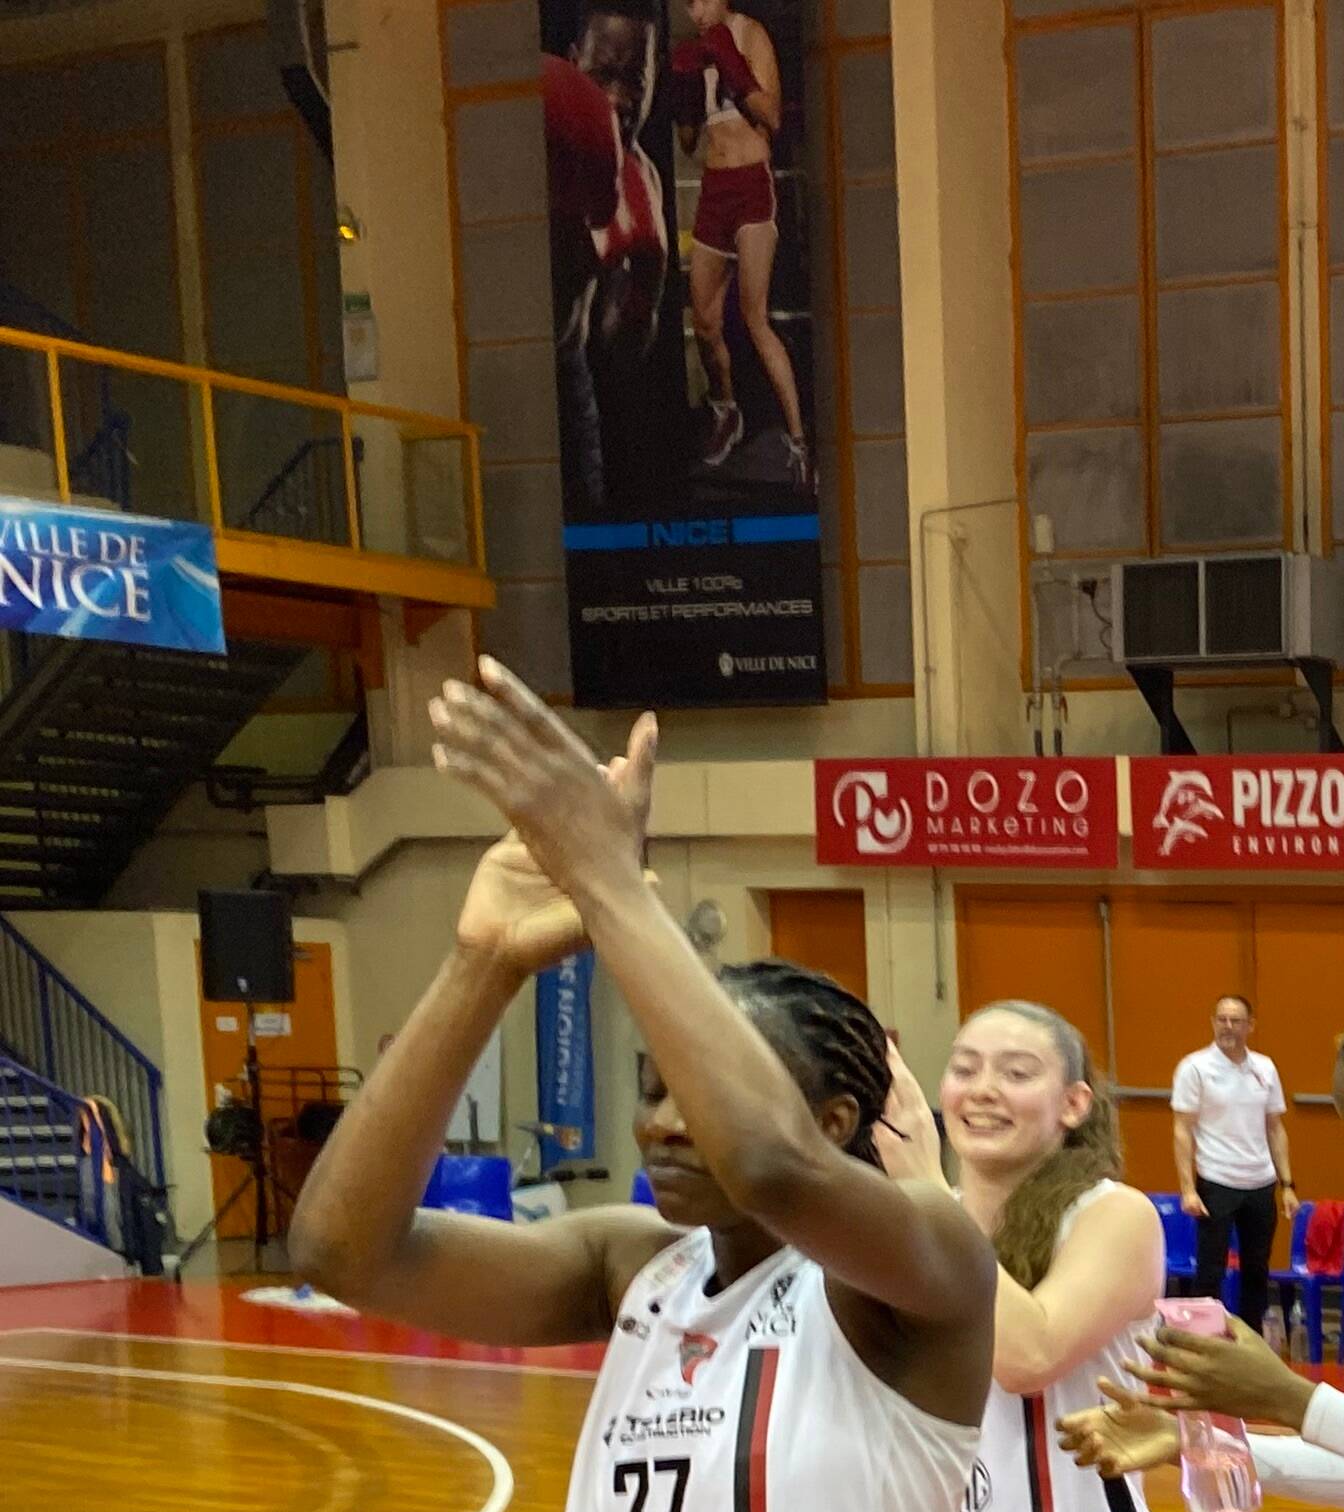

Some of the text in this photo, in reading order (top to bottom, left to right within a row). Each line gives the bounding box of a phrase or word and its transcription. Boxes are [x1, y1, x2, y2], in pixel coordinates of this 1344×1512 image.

[651, 519, 729, 546] NICE
[98, 531, 148, 568] DE
[0, 554, 151, 624] NICE
[646, 577, 689, 593] VILLE
[926, 769, 1089, 813] DOZO
[926, 816, 1090, 838] MARKETING
